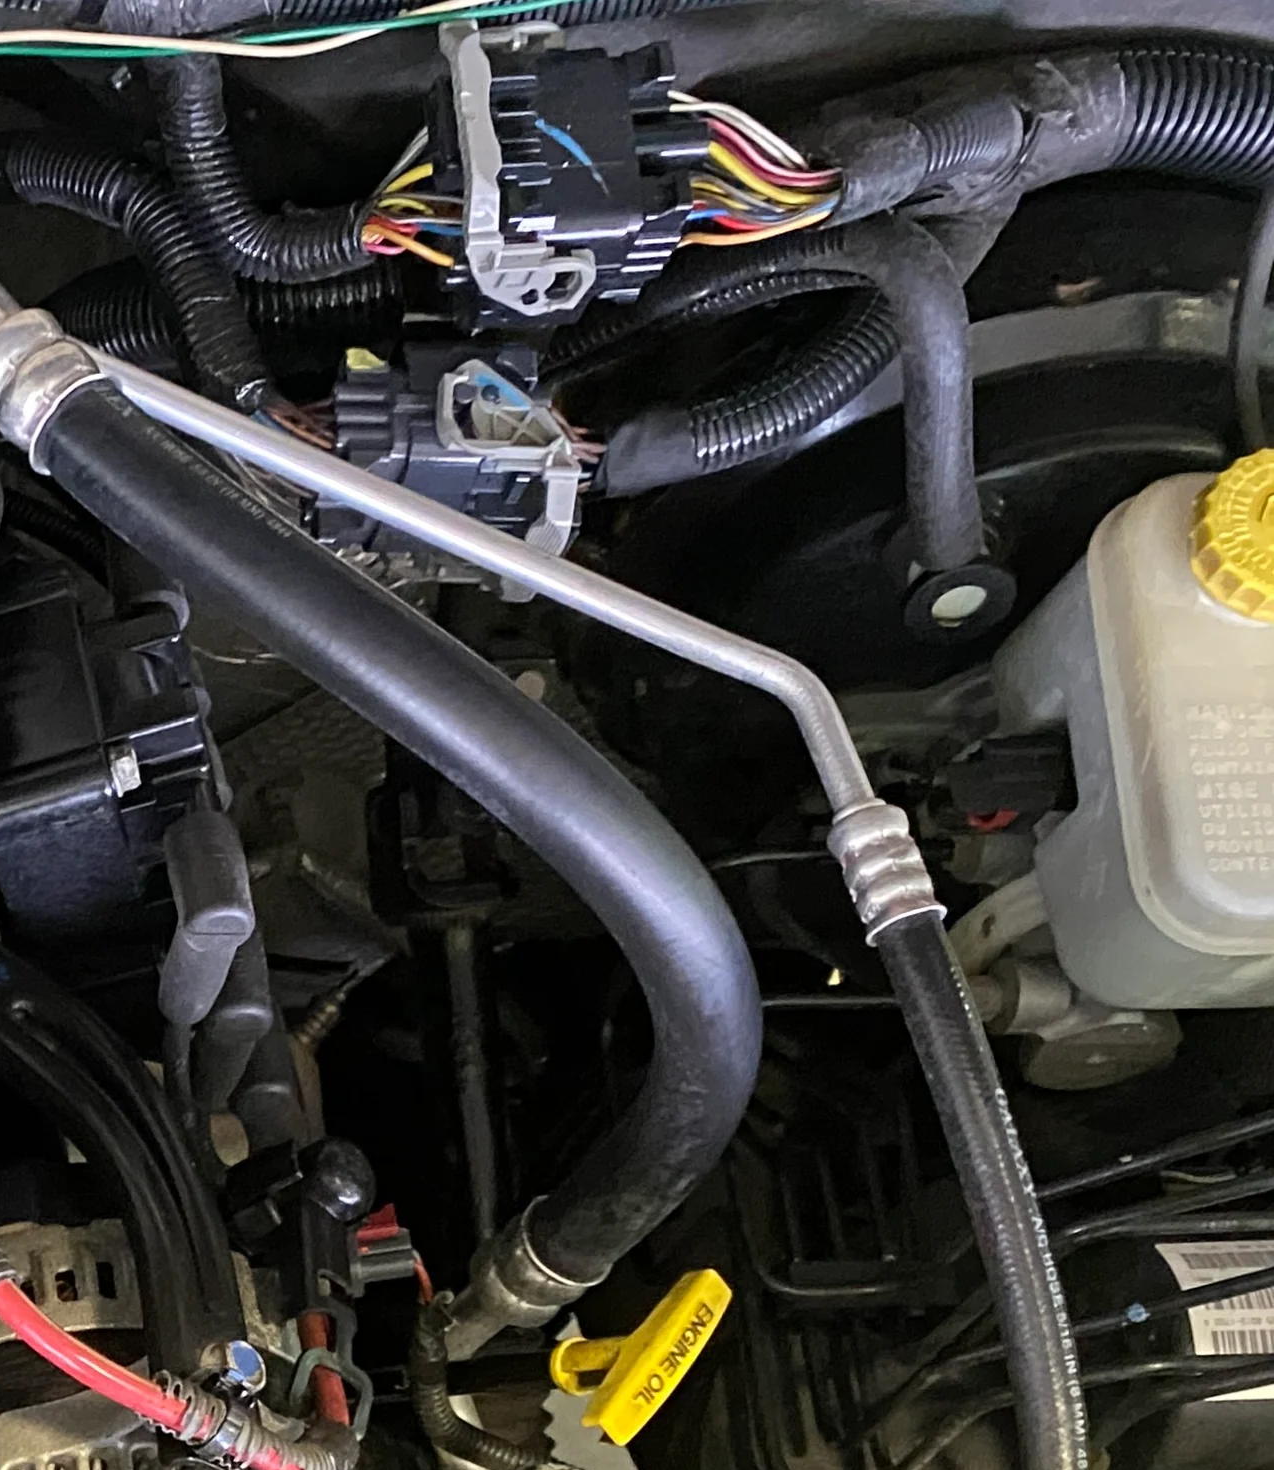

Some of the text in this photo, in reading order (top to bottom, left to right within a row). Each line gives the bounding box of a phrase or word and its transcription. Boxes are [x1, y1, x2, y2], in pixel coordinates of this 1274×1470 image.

[995, 1087, 1035, 1198] GALAXY
[1043, 1252, 1067, 1310] HOSE
[632, 1302, 714, 1406] ENGINE OIL
[1063, 1353, 1078, 1377] IN
[1070, 1401, 1087, 1443] MM)
